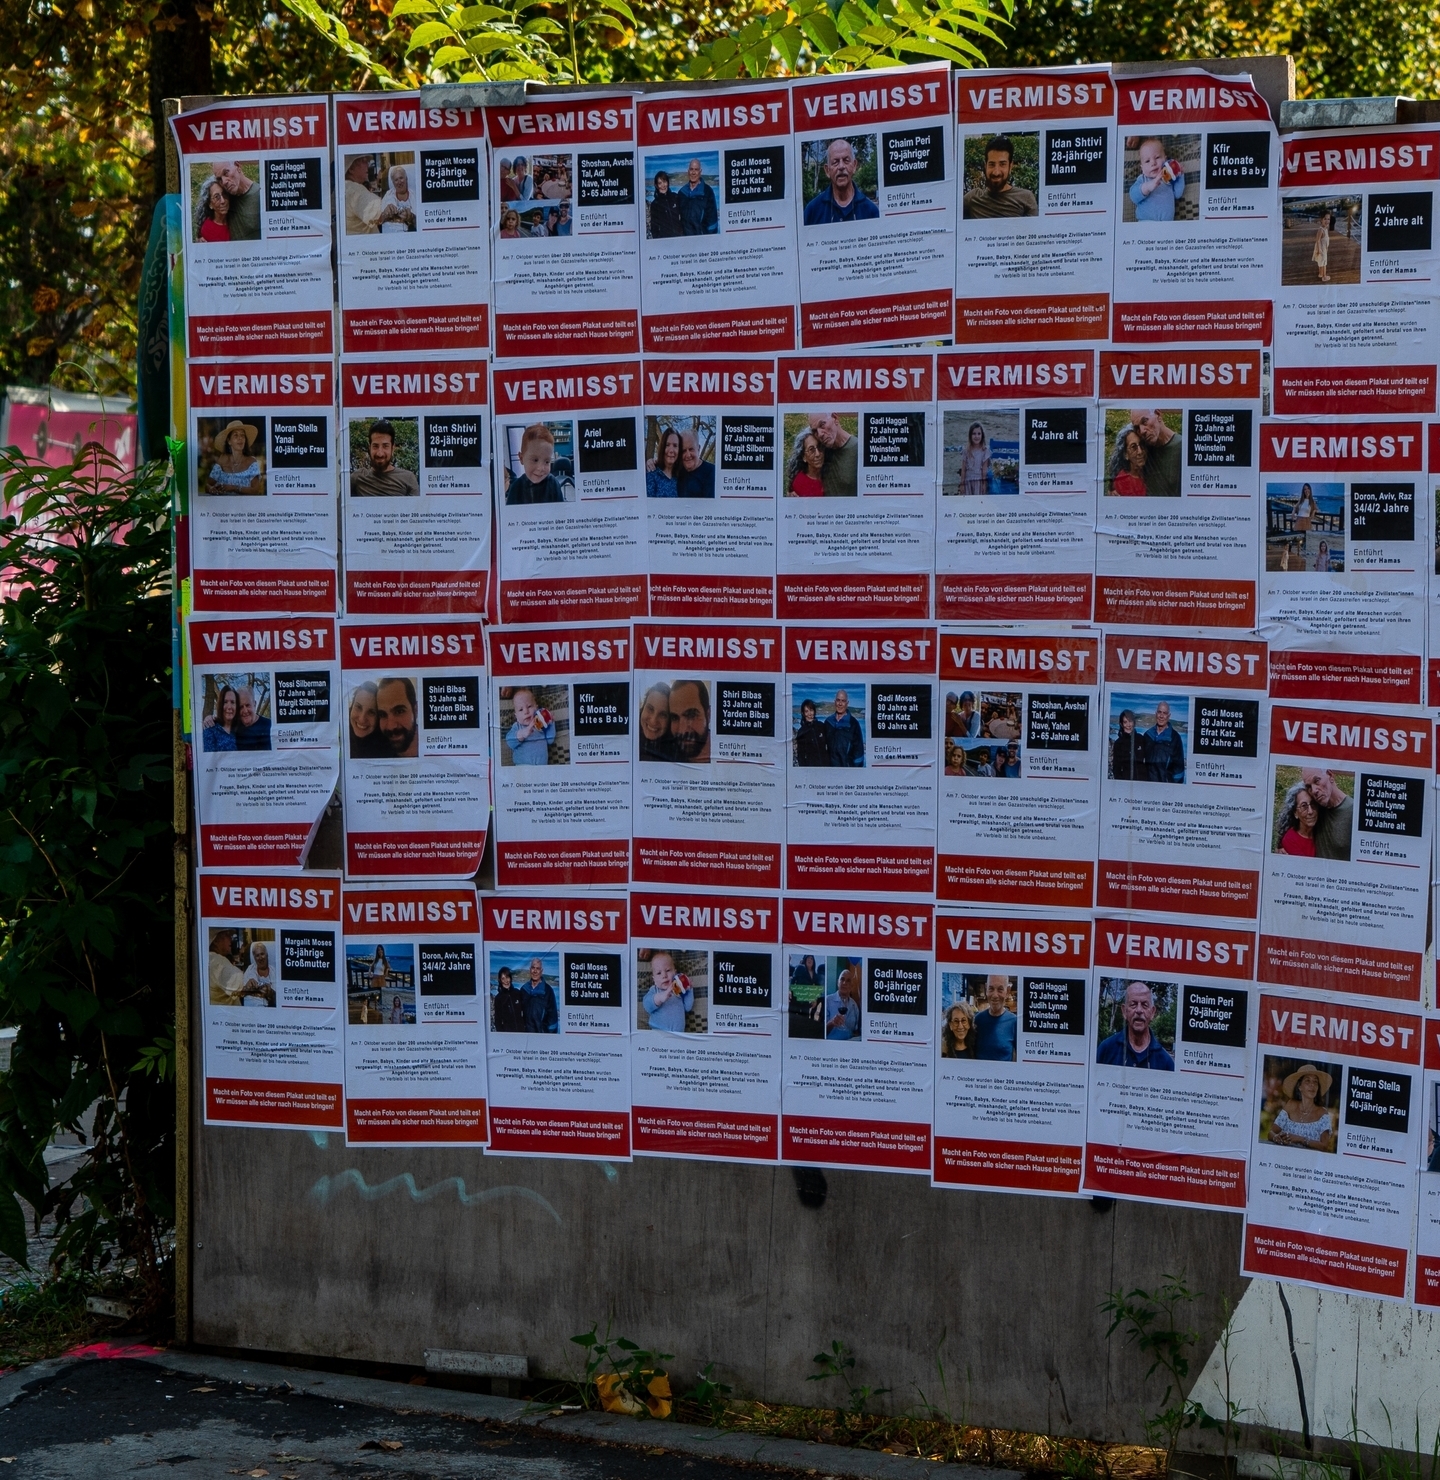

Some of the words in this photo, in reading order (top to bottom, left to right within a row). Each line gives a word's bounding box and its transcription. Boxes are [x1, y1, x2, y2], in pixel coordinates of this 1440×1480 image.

[803, 81, 940, 117] VERMISST
[968, 83, 1106, 109] VERMISST
[188, 115, 319, 140] VERMISST
[888, 137, 913, 148] Chaim
[915, 135, 930, 145] Peri
[452, 156, 475, 164] Moses
[889, 148, 930, 161] 79-jähriger
[425, 166, 466, 178] 78-jährige
[889, 160, 928, 172] Großvater
[425, 178, 473, 188] Großmutter
[788, 367, 924, 389] VERMISST
[1110, 363, 1252, 385] VERMISST
[199, 373, 325, 394] VERMISST
[503, 373, 633, 401] VERMISST
[274, 423, 296, 432] Moran
[297, 423, 317, 432] Stella
[1031, 419, 1047, 428] Raz
[274, 434, 294, 443] Yanai
[1031, 431, 1036, 440] 4
[1039, 430, 1064, 440] Jahre
[1066, 430, 1078, 439] alt
[274, 445, 307, 455] 40-jährige
[309, 445, 324, 453] Frau
[1271, 435, 1414, 458] VERMISST
[202, 628, 327, 651] VERMISST
[350, 634, 475, 656] VERMISST
[950, 647, 1089, 671] VERMISST
[211, 886, 333, 908] VERMISST
[421, 951, 443, 959] Doron,
[444, 951, 459, 959] Aviv,
[460, 951, 473, 959] Raz
[422, 961, 445, 970] 34/4/2
[448, 961, 470, 970] Jahre
[422, 973, 433, 981] alt
